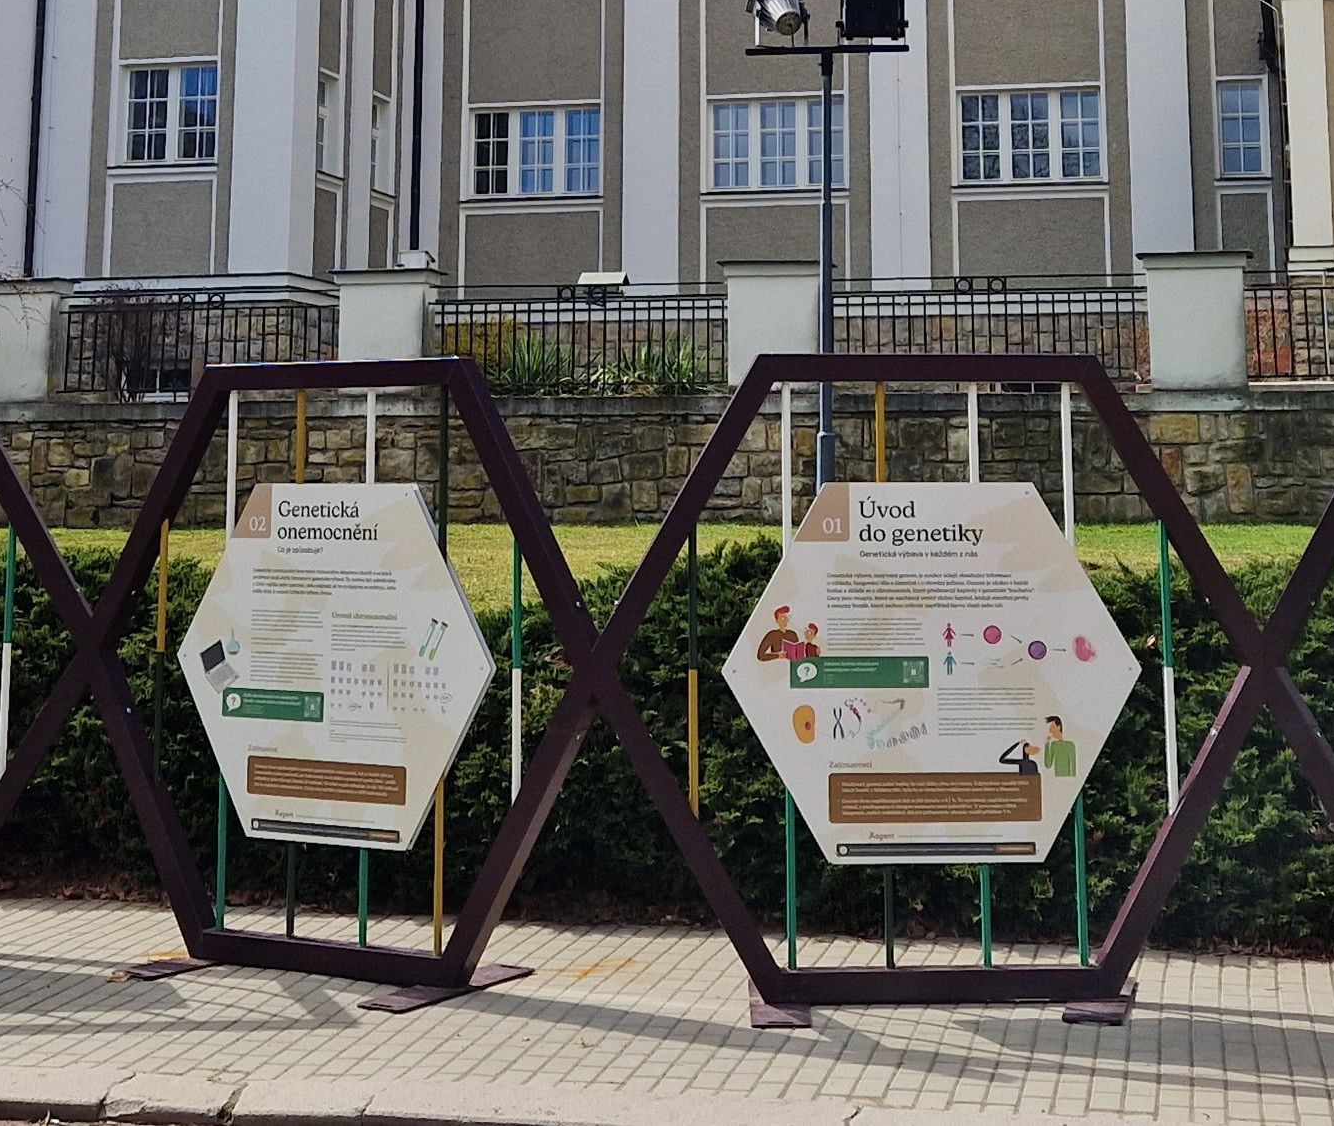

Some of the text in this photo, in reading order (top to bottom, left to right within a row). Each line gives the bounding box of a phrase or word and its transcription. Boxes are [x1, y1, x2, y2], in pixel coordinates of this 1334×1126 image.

[278, 500, 360, 519] Genetická
[859, 496, 916, 519] Úvod
[249, 516, 266, 532] 02
[277, 522, 379, 541] onemocnění
[822, 517, 843, 534] 01
[859, 524, 984, 546] do genetiky
